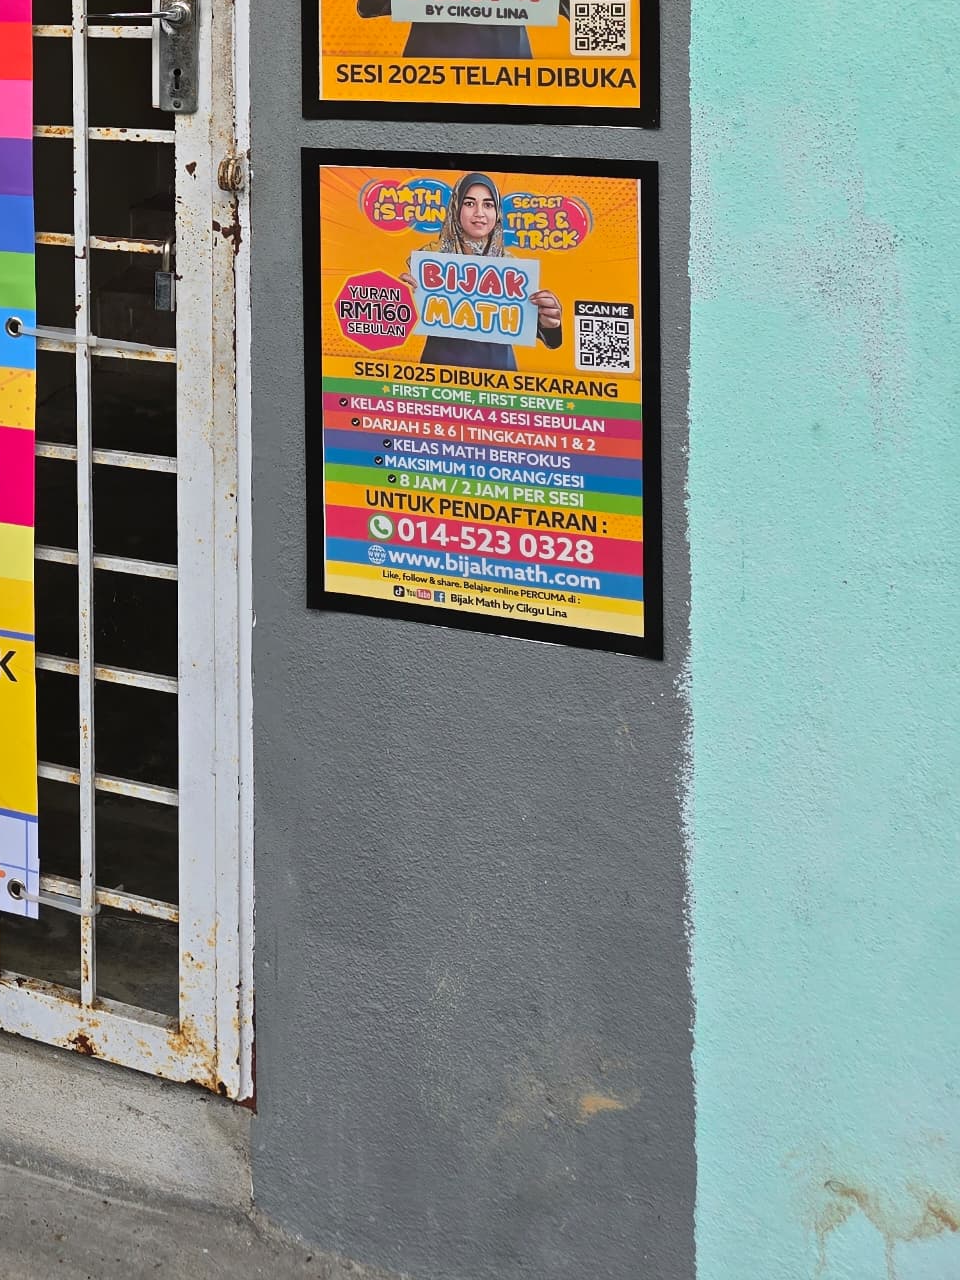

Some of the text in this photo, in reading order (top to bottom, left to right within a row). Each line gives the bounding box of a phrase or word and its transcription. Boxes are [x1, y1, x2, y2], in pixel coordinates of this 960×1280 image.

[425, 5, 528, 19] BY CIKGU LINA
[336, 64, 637, 89] SESI 2025 TELAH DIBUKA
[349, 286, 400, 302] YURAN
[421, 263, 526, 298] BIJAK
[340, 303, 411, 322] RM160
[425, 297, 520, 334] MATH
[347, 322, 405, 337] SEBULAN
[354, 362, 619, 398] SESI 2025 DIBUKA SEKARANG
[392, 384, 564, 411] FIRST COME, FIRST SERVE
[351, 397, 605, 432] KELAS BERSEMUKA SESI SEBULAN
[362, 417, 557, 448] DARJAH TINGKATAN
[393, 439, 571, 469] KELAS MATH BERFOKUS
[385, 455, 585, 488] MAKSIMUM 10 ORANG/SESI
[413, 476, 584, 507] JAM JAM PER SESI
[366, 490, 598, 533] UNTUK PENDAFTARAN
[398, 518, 594, 564] 014-523 0328
[388, 549, 601, 590] www.bijakmath.com
[383, 571, 566, 602] Like, follow share. Belajar online PERCUMA
[451, 594, 567, 618] Bijak Math by Cikgu Lina
